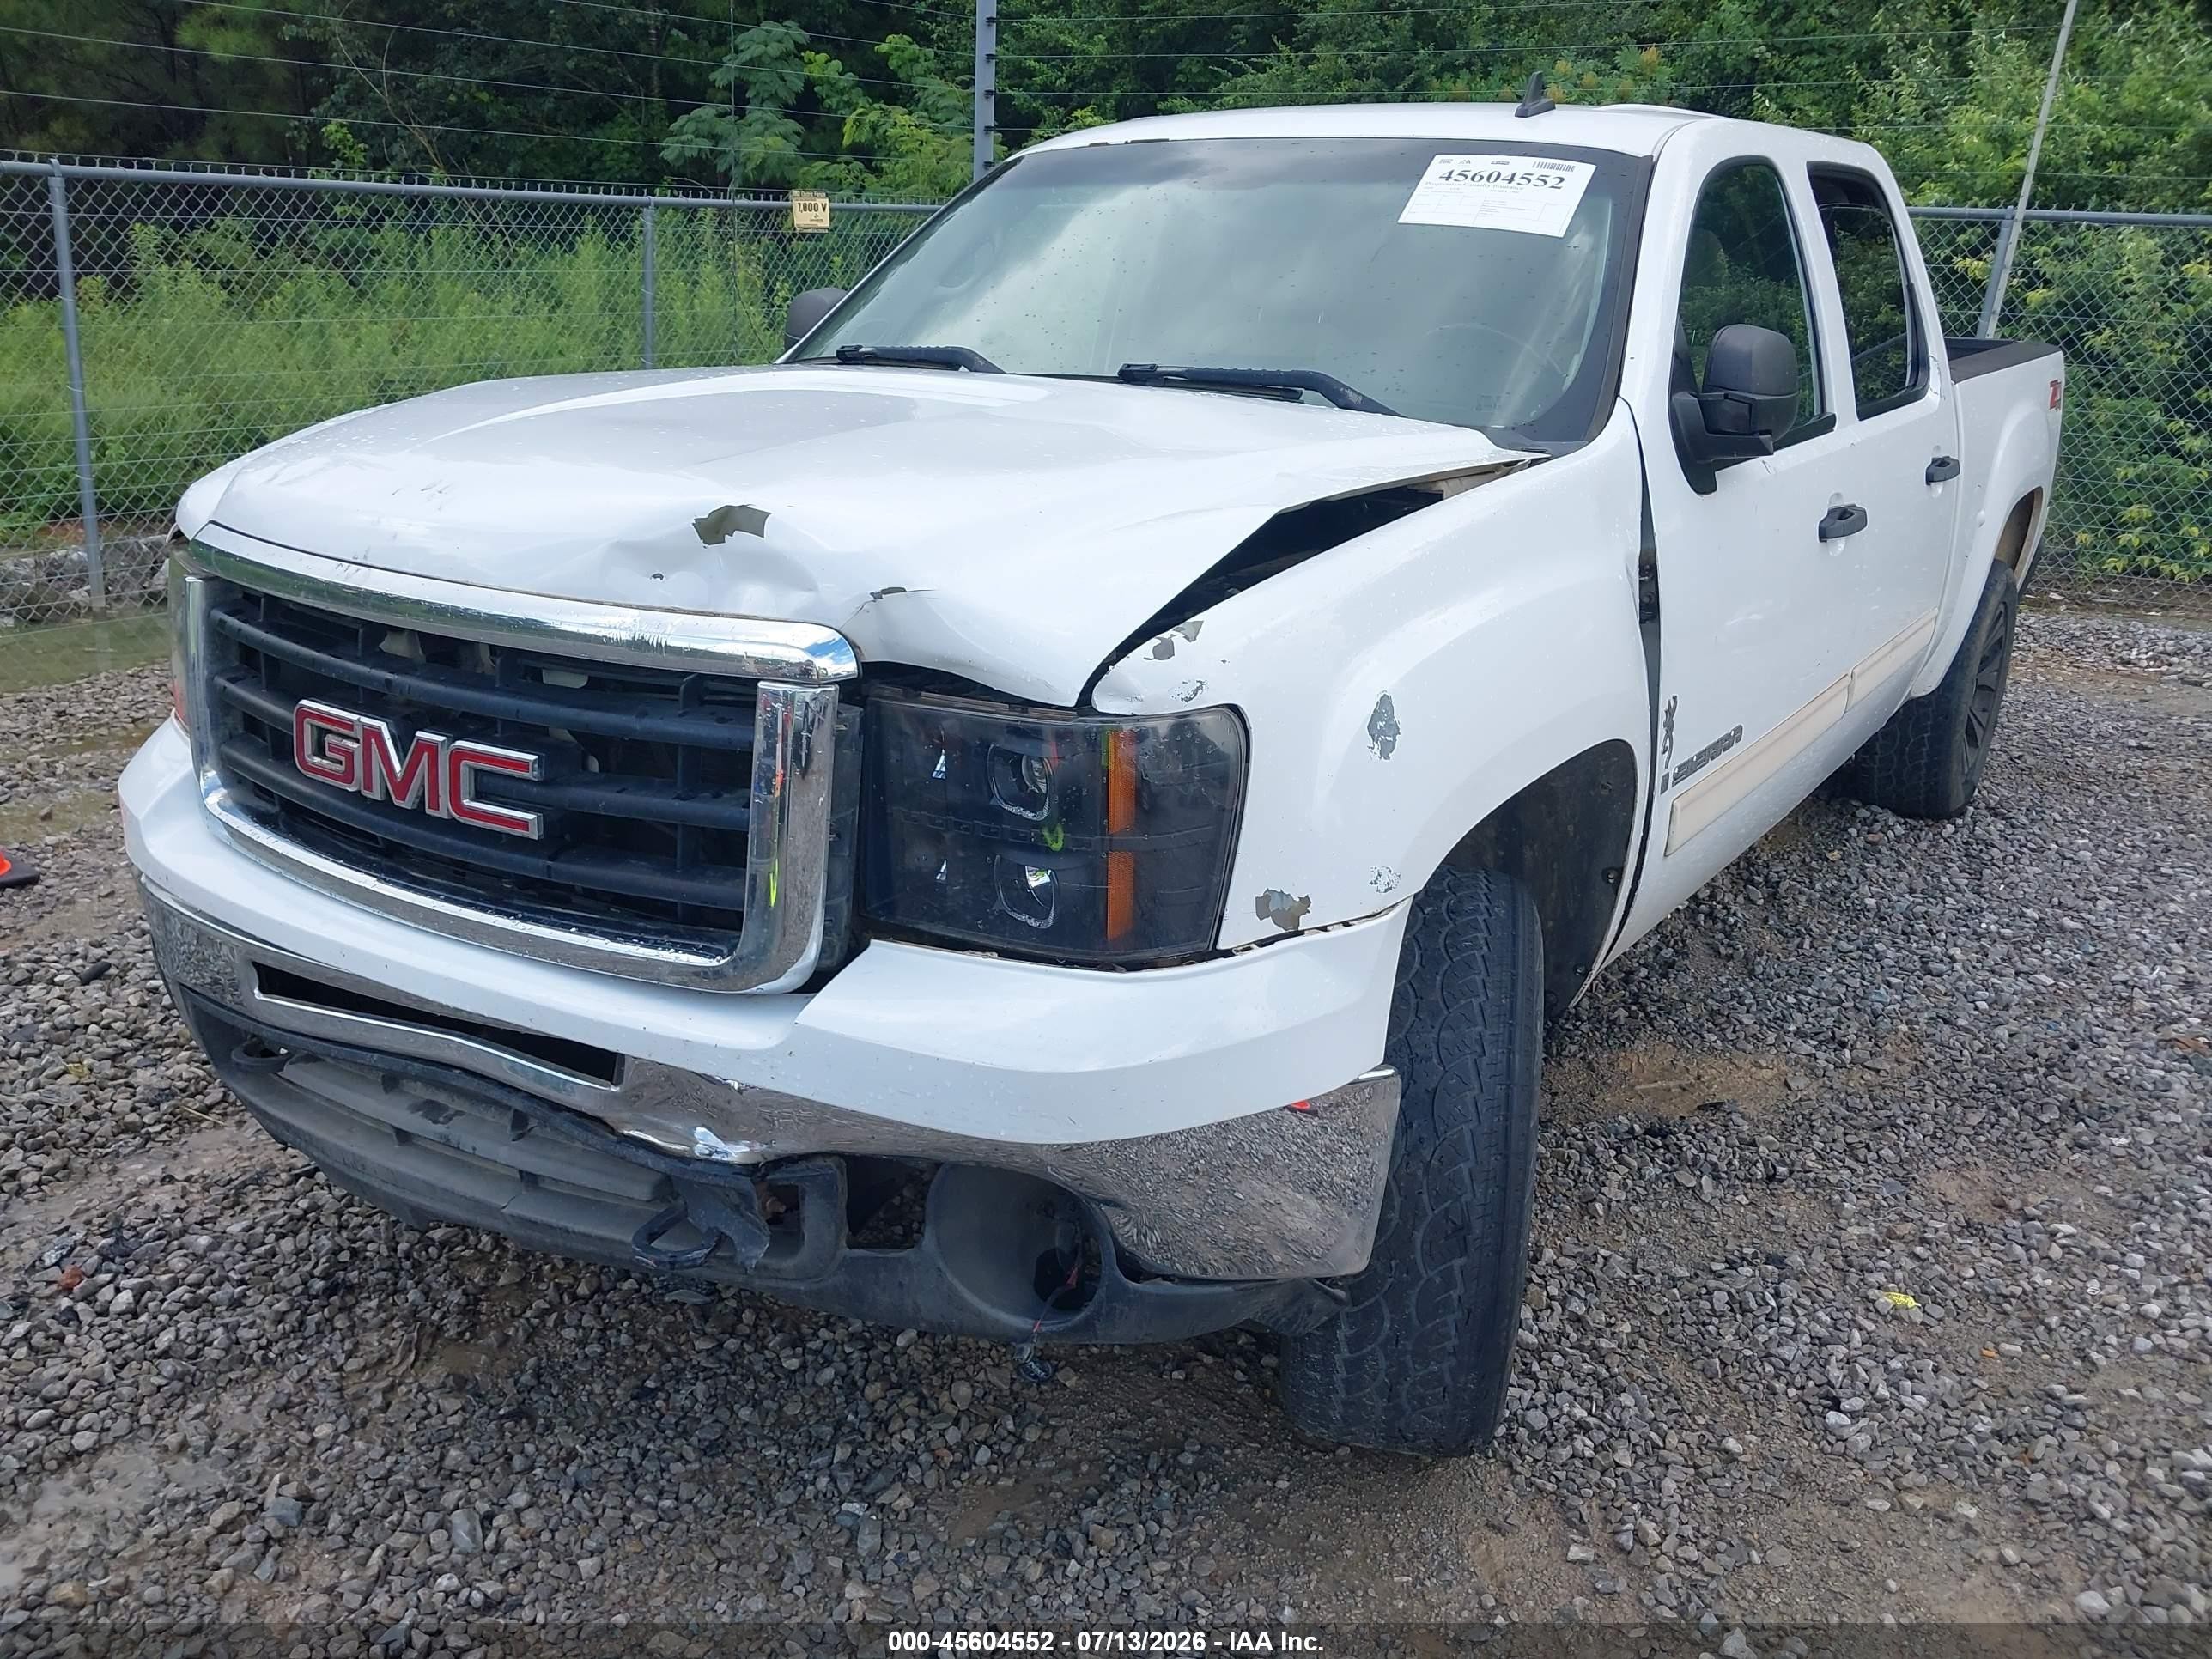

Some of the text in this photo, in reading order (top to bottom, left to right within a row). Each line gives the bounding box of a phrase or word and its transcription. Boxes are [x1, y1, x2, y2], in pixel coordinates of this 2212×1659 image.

[1438, 169, 1565, 190] 45604552
[798, 203, 827, 213] 7,000 V
[294, 699, 544, 840] GMC
